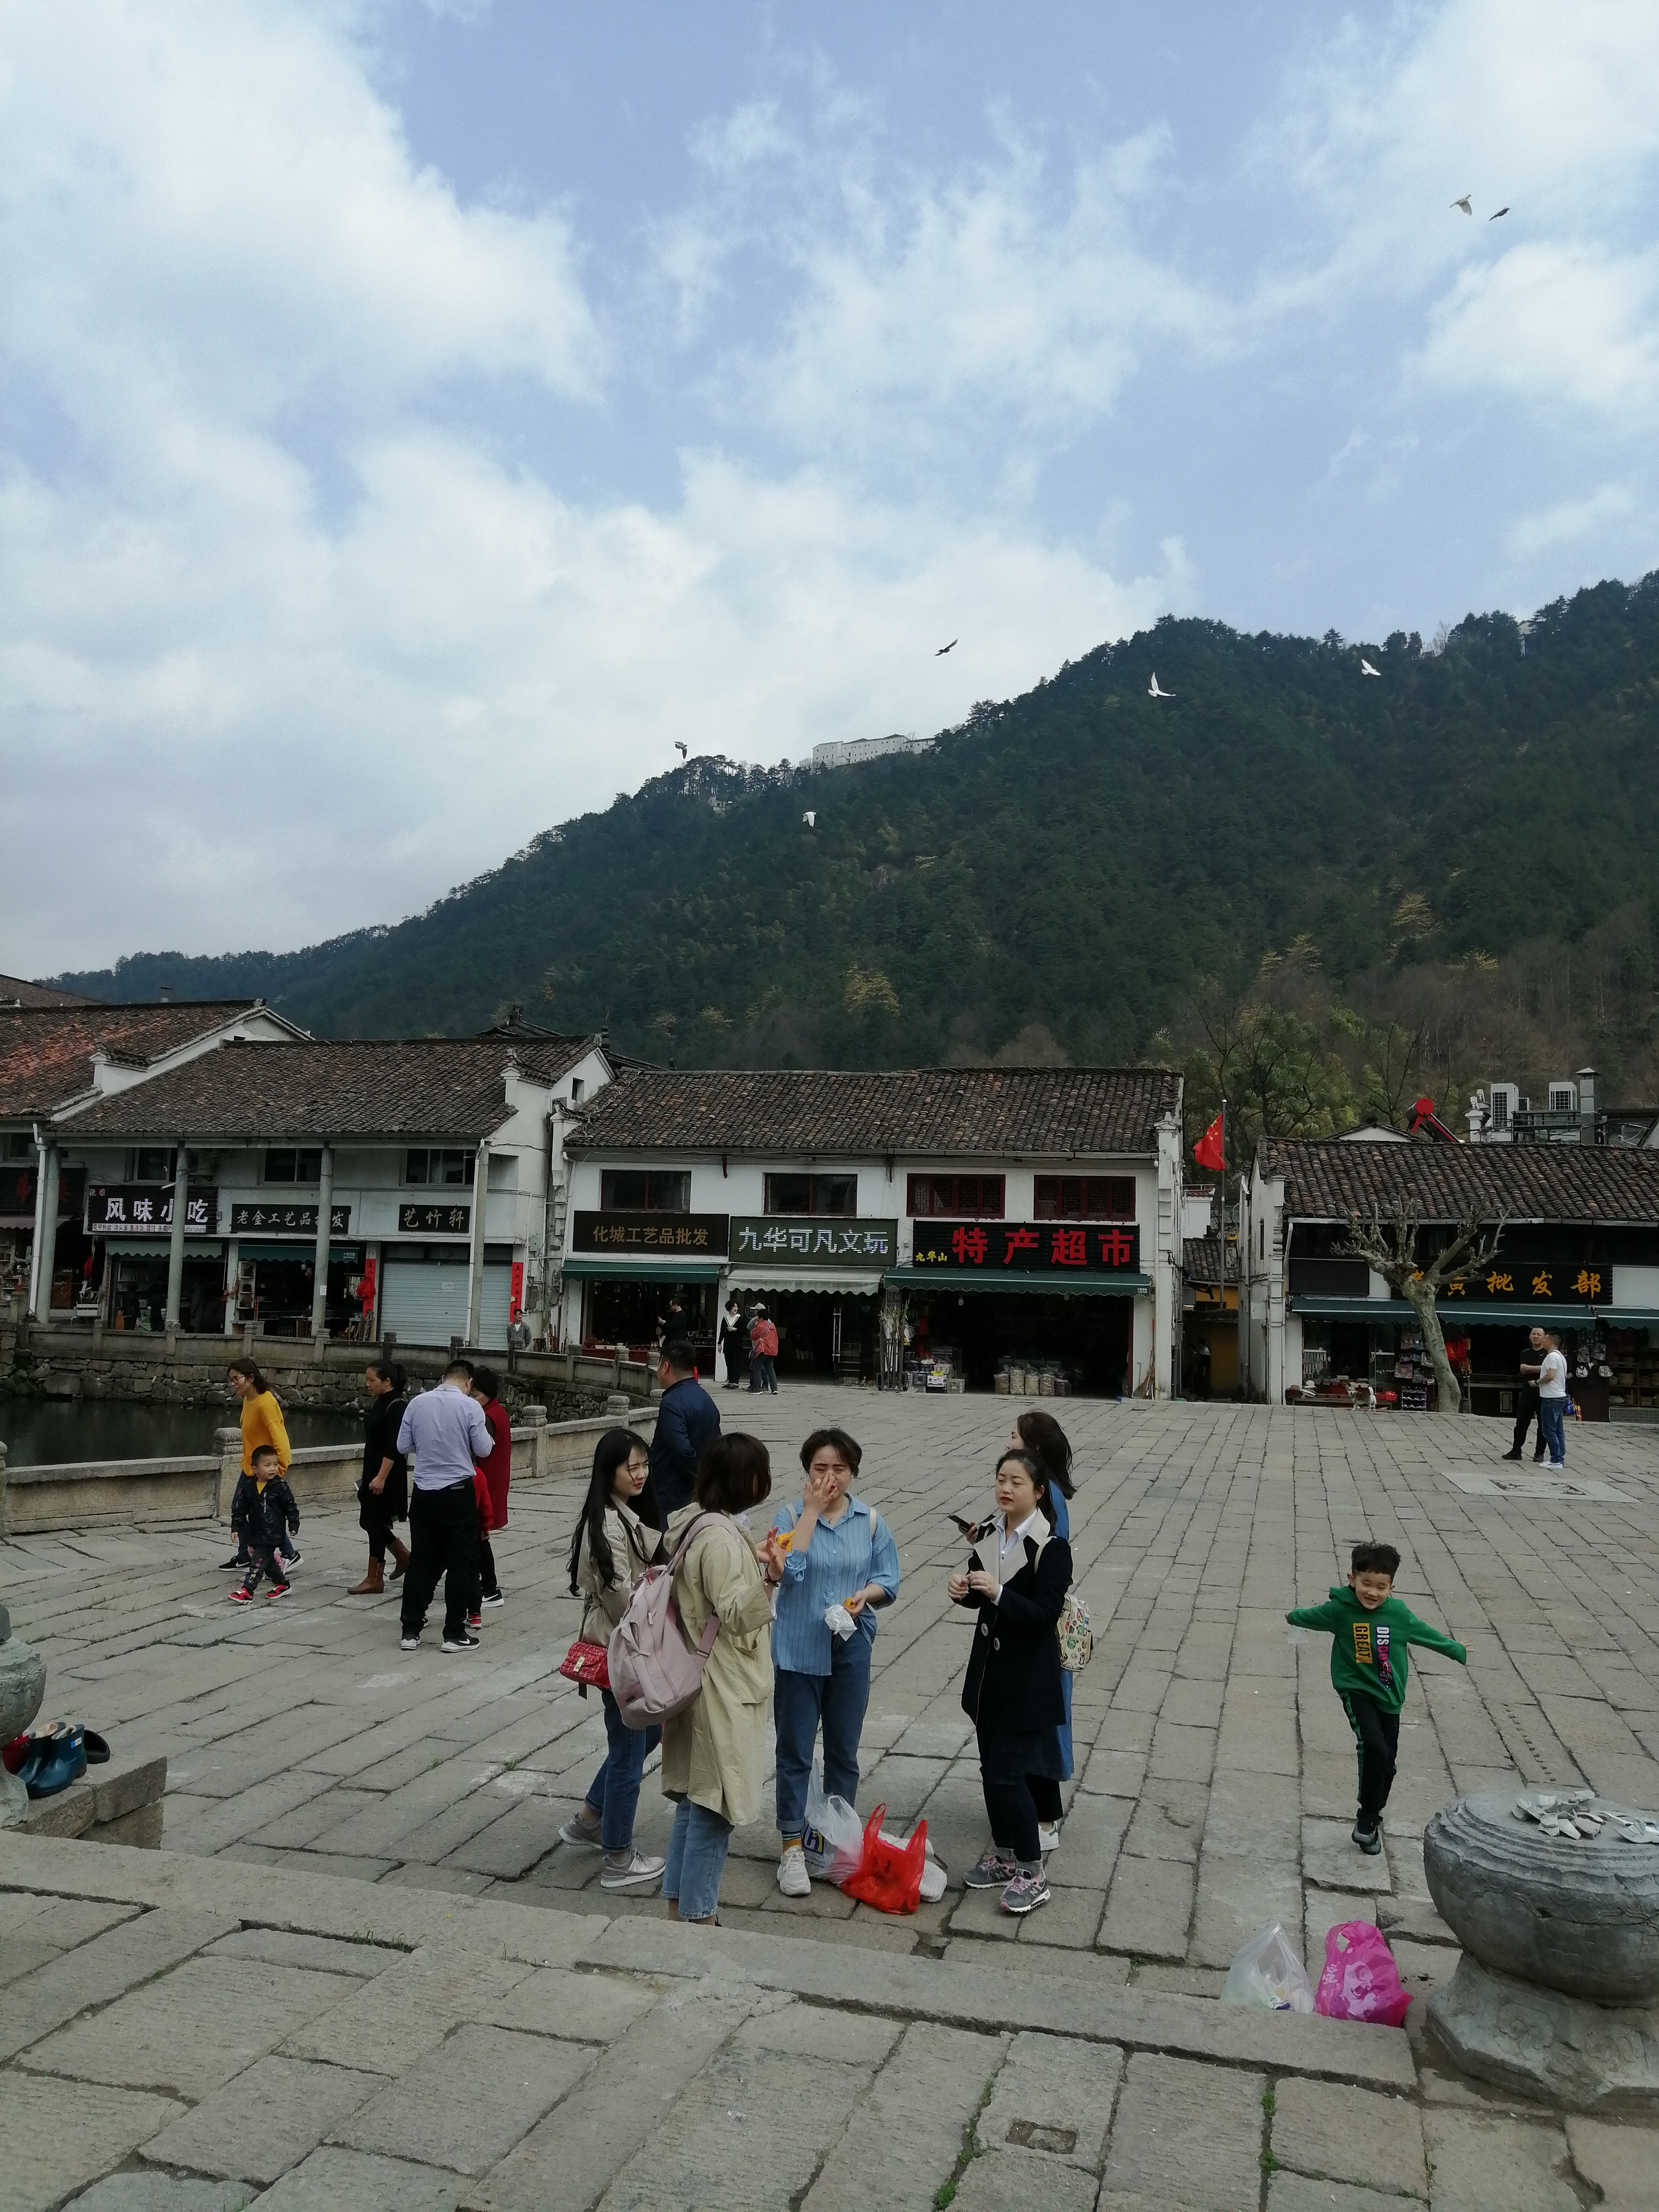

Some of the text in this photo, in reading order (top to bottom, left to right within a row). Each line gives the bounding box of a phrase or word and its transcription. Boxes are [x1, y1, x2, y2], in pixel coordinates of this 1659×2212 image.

[105, 1198, 208, 1223] 风味小吃
[237, 1210, 344, 1228] 老金工艺品发
[404, 1208, 465, 1230] 艺竹轩
[593, 1225, 709, 1246] 化城工艺品批发
[738, 1227, 889, 1254] 九华可凡文玩
[952, 1227, 1134, 1266] 特产超市
[1355, 1626, 1370, 1657] GREAT
[1376, 1627, 1392, 1681] DISCO
